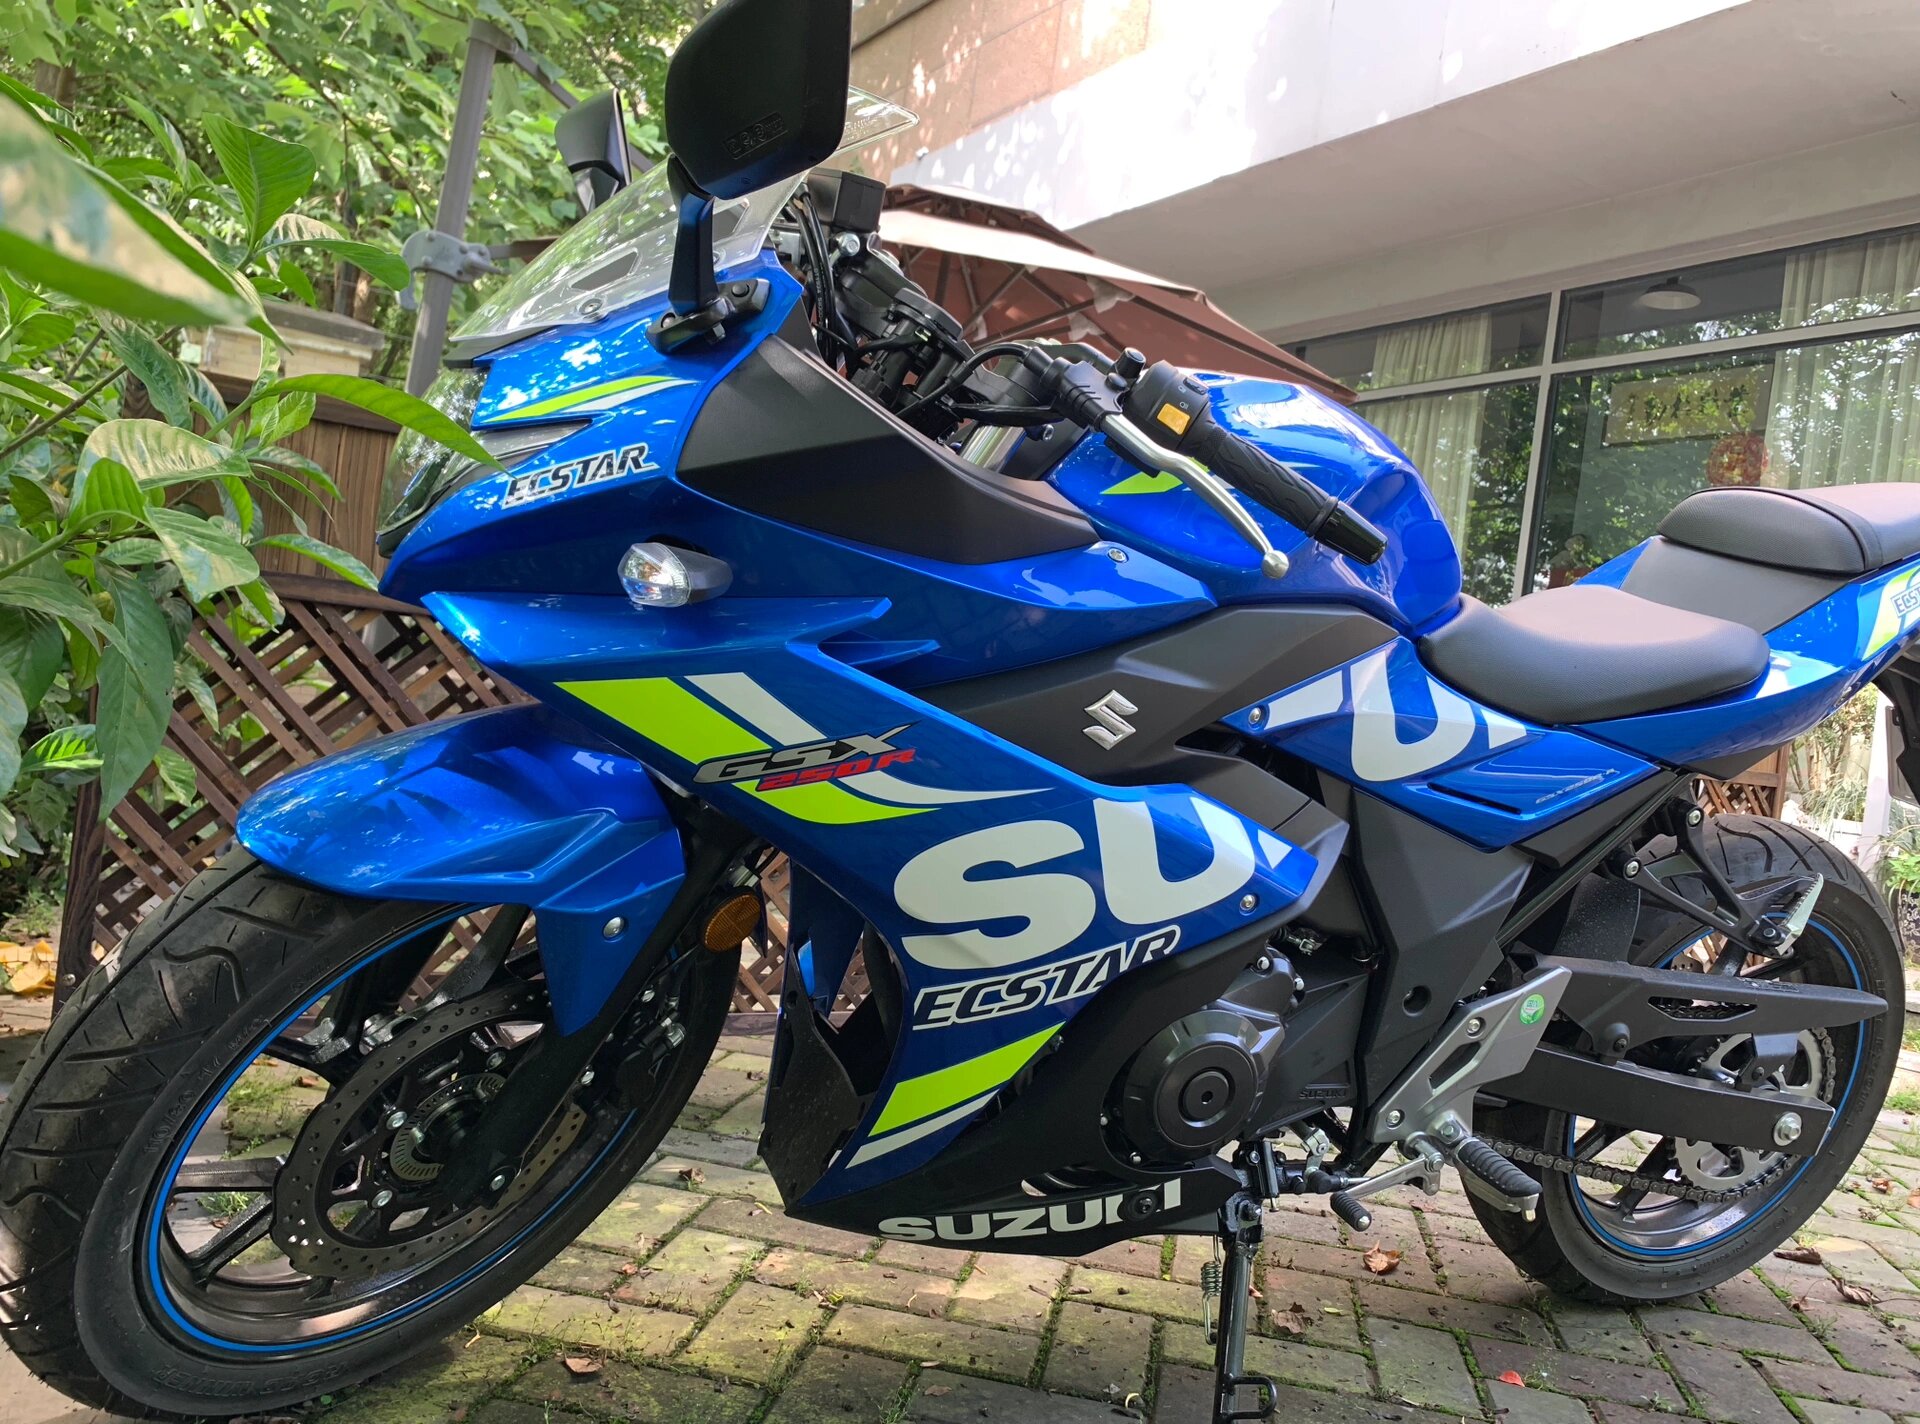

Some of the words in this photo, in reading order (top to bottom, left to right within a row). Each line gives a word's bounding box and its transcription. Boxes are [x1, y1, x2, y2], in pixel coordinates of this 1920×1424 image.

[502, 443, 660, 510] ECSTAR
[693, 722, 916, 784] GSX
[894, 797, 1292, 970] SU
[912, 924, 1181, 1031] ECSTAR
[1298, 1088, 1347, 1100] SUZUKI
